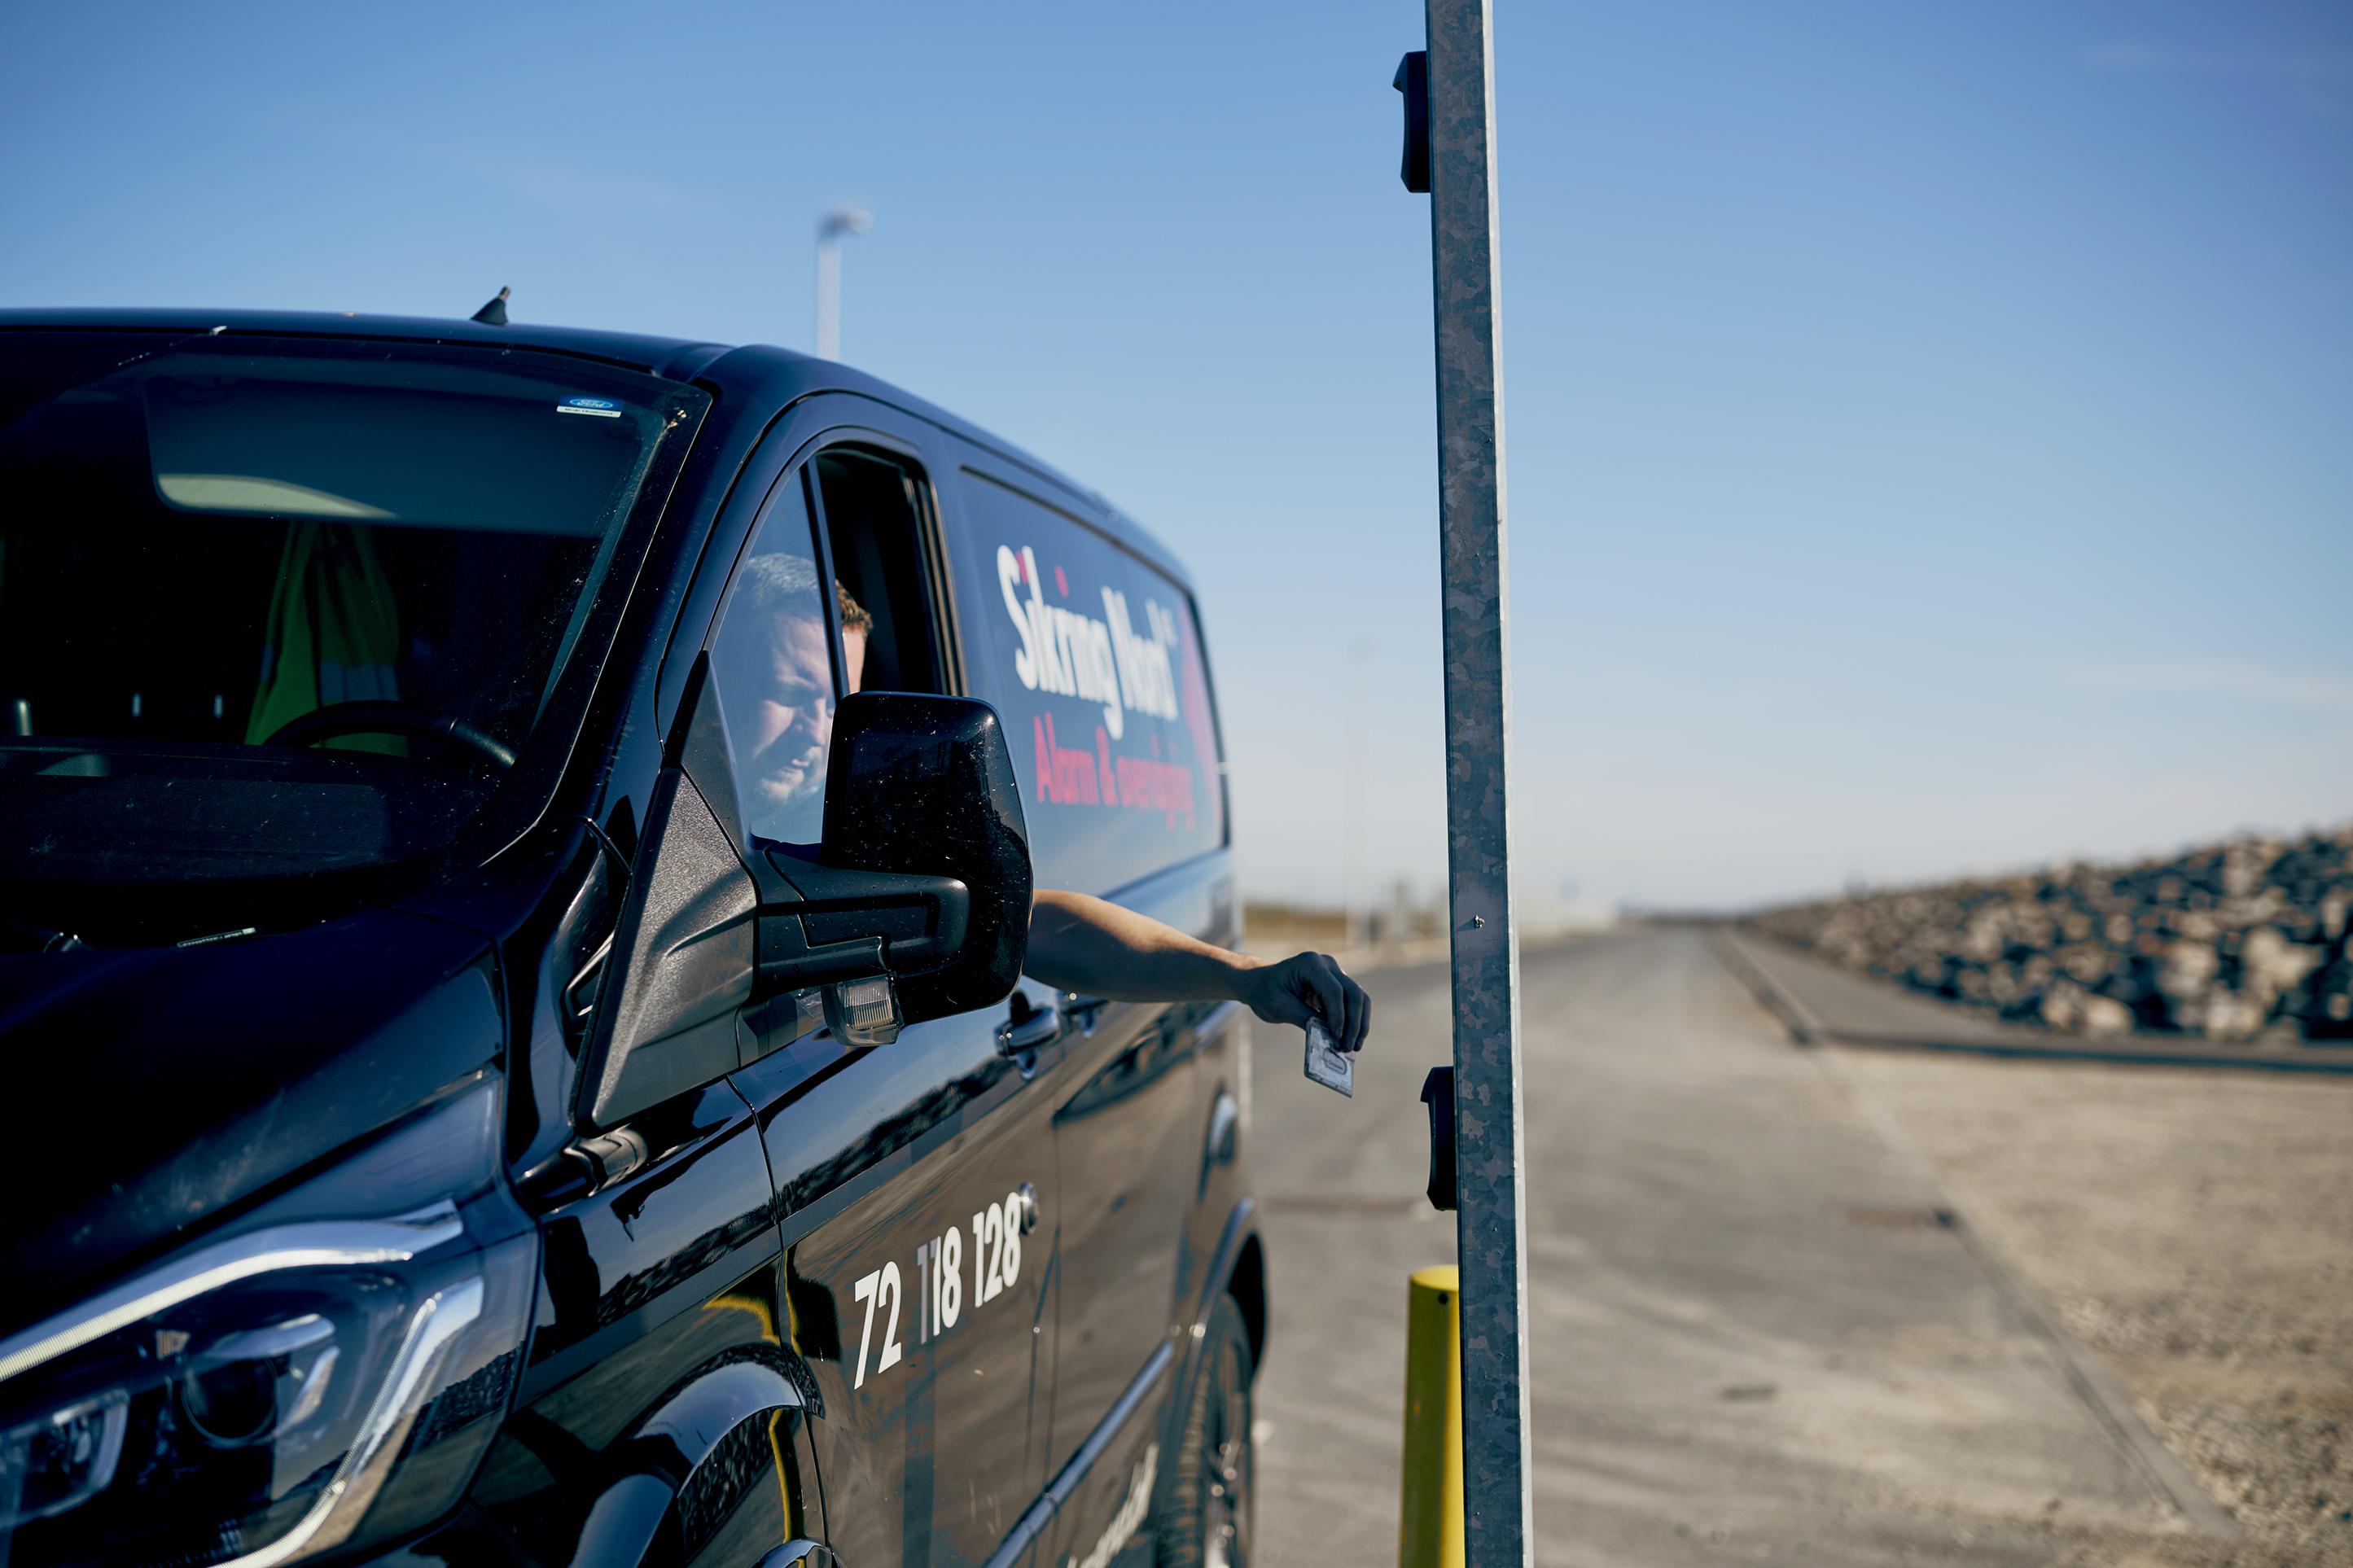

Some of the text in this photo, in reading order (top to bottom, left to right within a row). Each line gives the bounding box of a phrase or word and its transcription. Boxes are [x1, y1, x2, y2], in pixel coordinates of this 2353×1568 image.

[1034, 711, 1099, 804] Alarm
[854, 1192, 1021, 1390] 72 118 128
